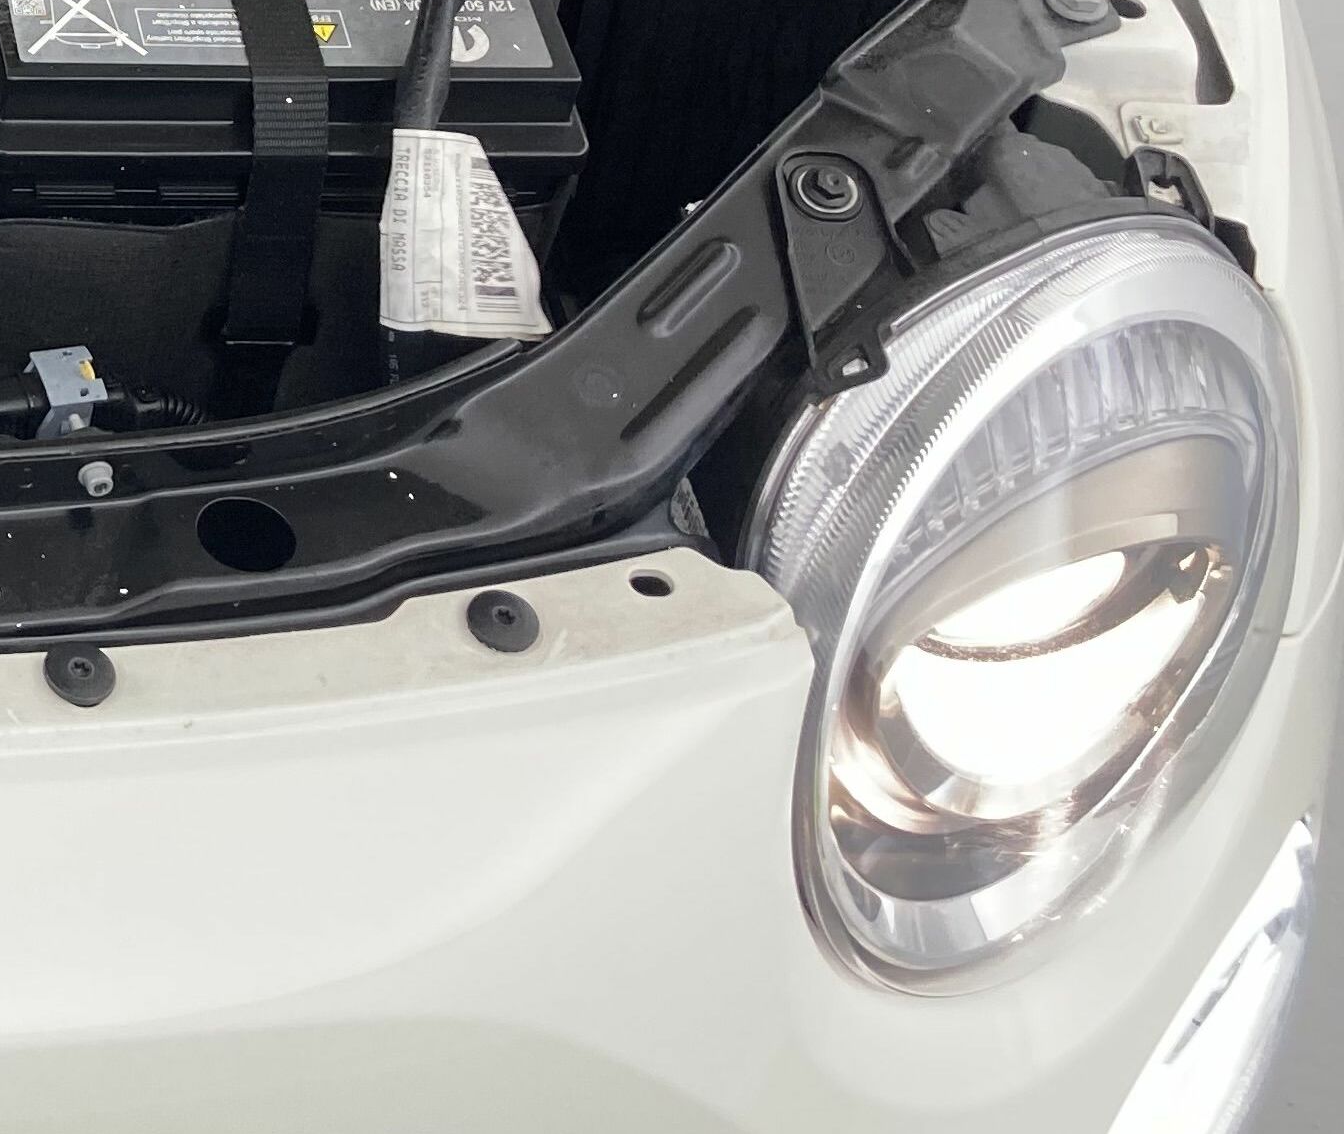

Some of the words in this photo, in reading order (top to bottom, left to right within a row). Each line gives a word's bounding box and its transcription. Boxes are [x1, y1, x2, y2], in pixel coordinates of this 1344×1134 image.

[488, 0, 517, 12] 12V
[393, 147, 411, 202] TRECCIA
[392, 209, 407, 224] DI
[391, 232, 407, 272] MASSA
